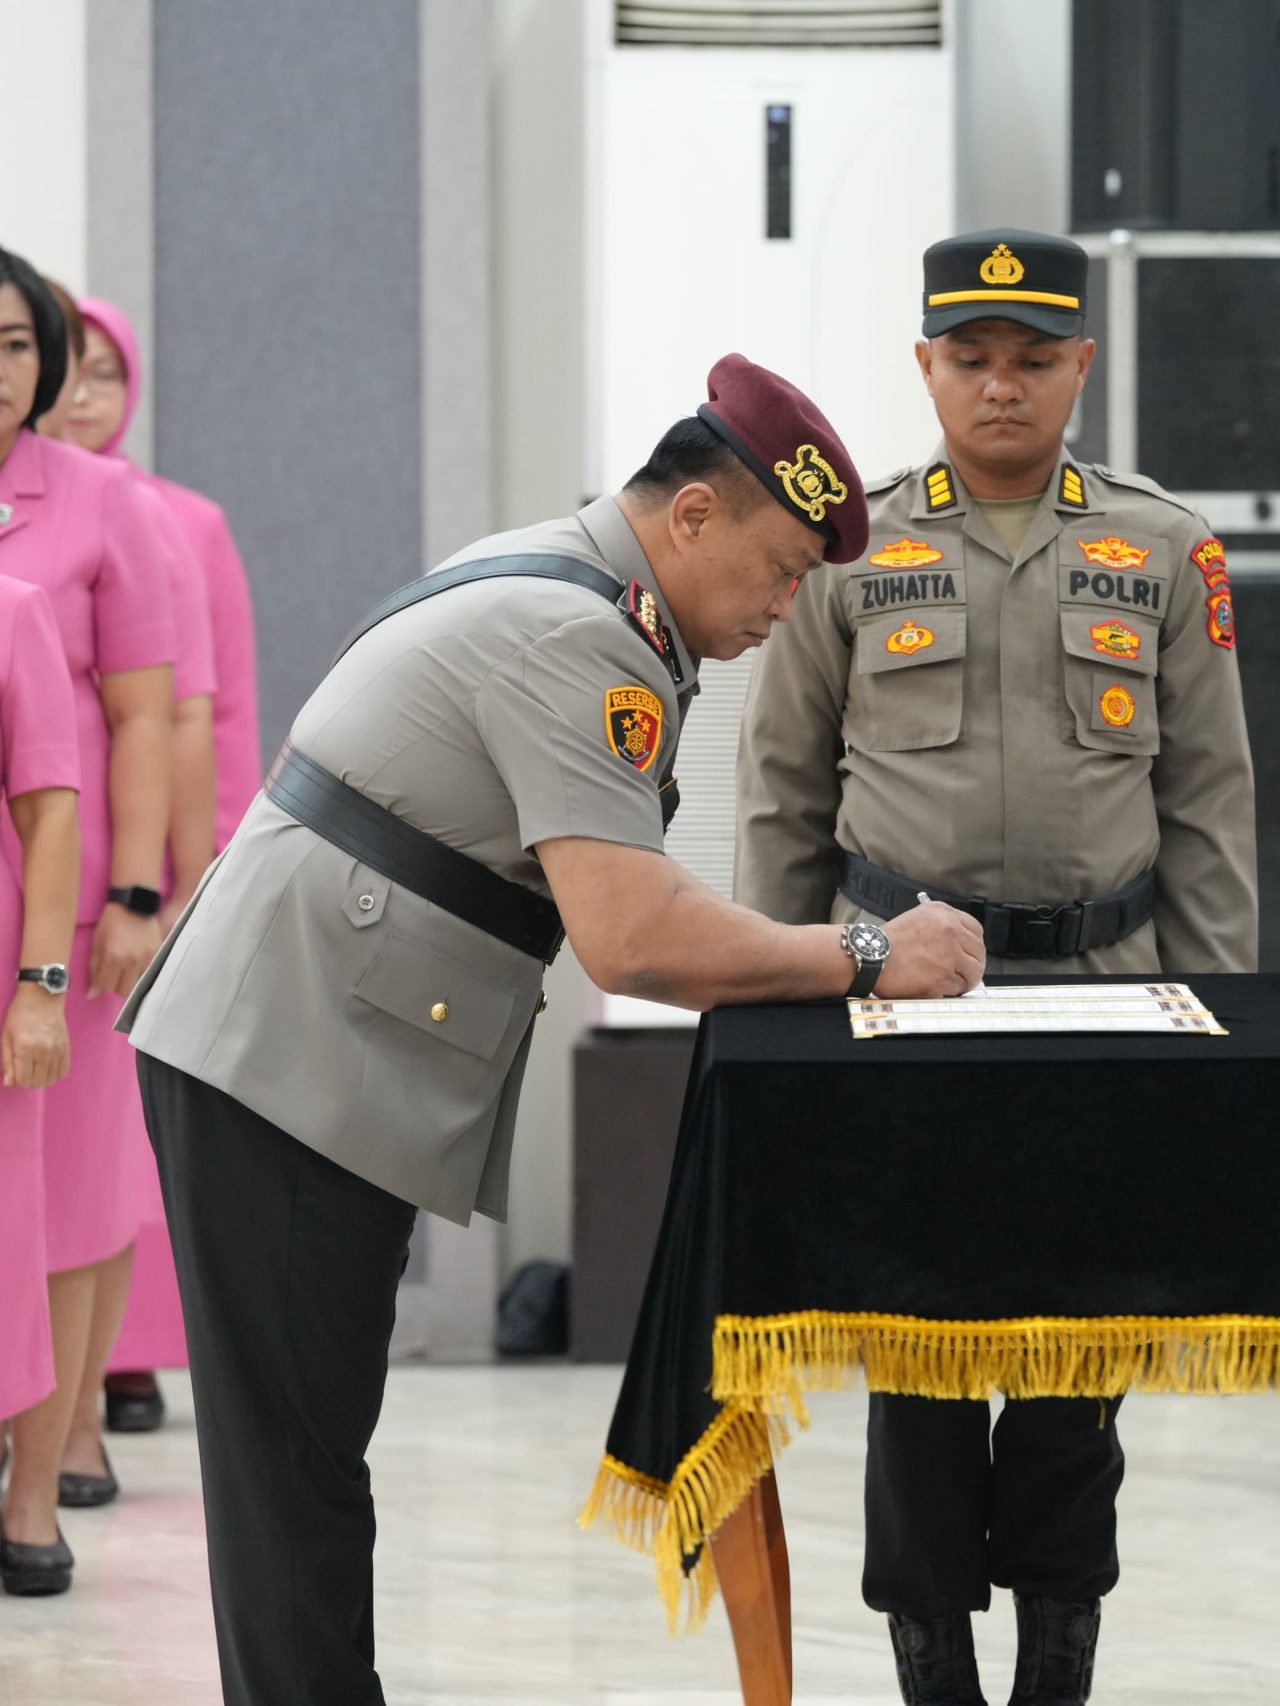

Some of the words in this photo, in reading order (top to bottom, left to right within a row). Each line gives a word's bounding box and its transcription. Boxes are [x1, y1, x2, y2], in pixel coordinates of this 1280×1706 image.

[861, 573, 956, 610] ZUHATTA
[1069, 570, 1160, 610] POLRI
[611, 692, 661, 714] RESERSE
